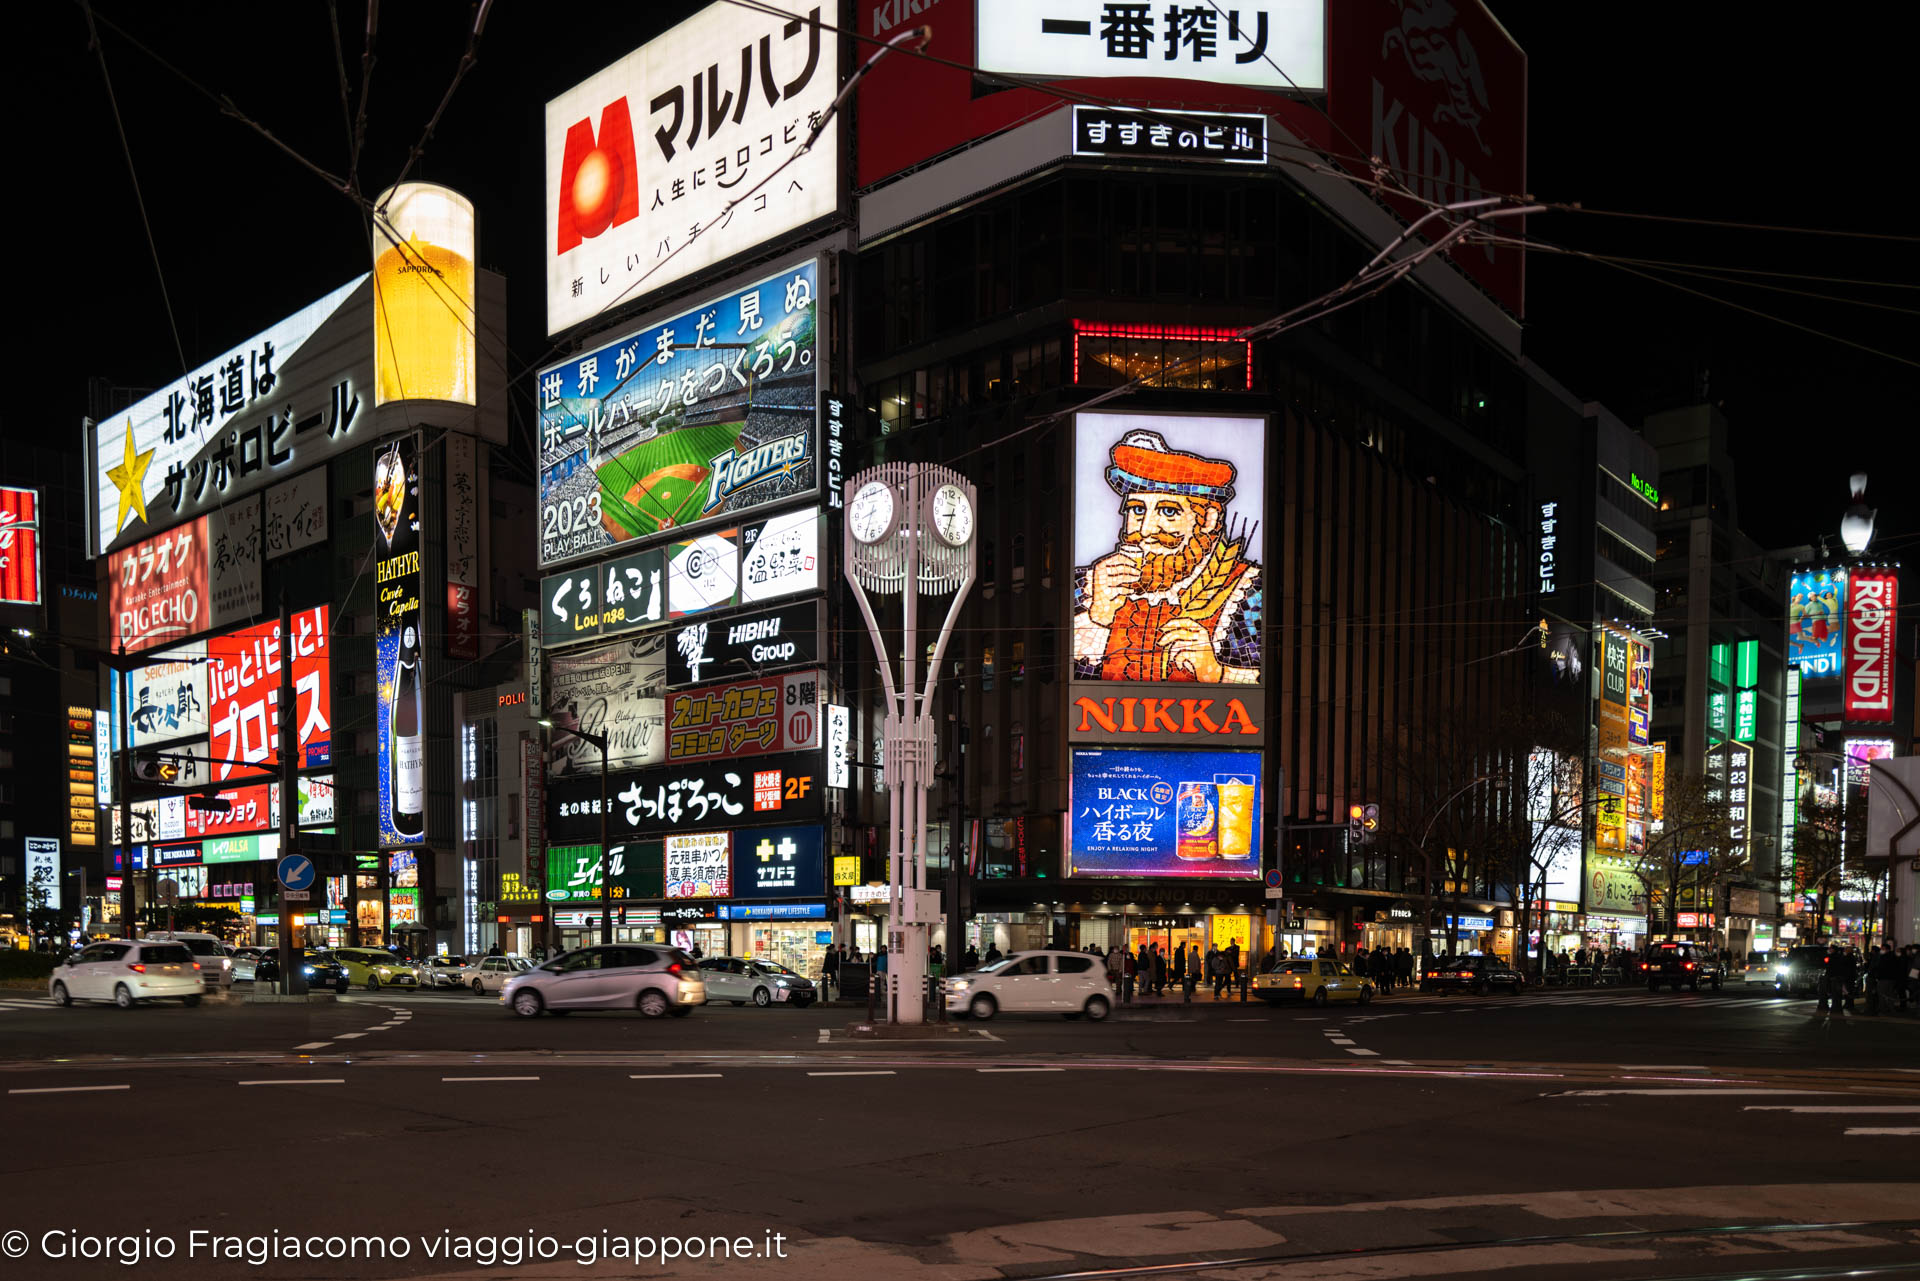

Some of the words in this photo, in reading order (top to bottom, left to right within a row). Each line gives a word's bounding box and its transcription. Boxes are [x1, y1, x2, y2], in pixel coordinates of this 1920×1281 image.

[1042, 3, 1269, 64] 一番搾り
[651, 6, 821, 163] マルハン
[1086, 120, 1254, 151] すすきのビル
[651, 110, 822, 211] 人生にヨロコビを
[571, 180, 804, 298] 新しいパチンコへ
[397, 265, 434, 275] SAPPORO
[542, 274, 811, 410] 世界がまだ見ぬ
[163, 341, 277, 444] 北海道は
[543, 331, 811, 452] ボールパークをつくろう。
[829, 399, 843, 509] すすきのビル
[703, 430, 809, 514] FIGHTERS
[543, 491, 603, 540] 2023
[544, 537, 571, 557] PLAY
[573, 532, 601, 551] BALL
[744, 528, 759, 544] 2F
[1540, 502, 1557, 593] すすきのビル
[122, 533, 192, 588] カラオケ
[377, 551, 420, 584] HATHYR
[149, 577, 189, 598] Entertainment
[380, 584, 404, 603] Cuvée
[552, 566, 643, 622] くろねこ
[119, 606, 150, 645] BIG
[151, 589, 199, 625] ECHO
[389, 597, 420, 617] Capella
[456, 585, 471, 645] カラオケ
[574, 607, 625, 631] Lounge
[728, 617, 781, 645] HIBIKI
[751, 642, 795, 662] Group
[1606, 643, 1626, 673] 快活
[786, 681, 816, 706] 8階
[1607, 674, 1625, 694] CLUB
[131, 680, 201, 733] 長次郎
[671, 687, 778, 729] ネットカフェ
[1074, 696, 1260, 734] NIKKA
[670, 730, 726, 758] コミック
[729, 721, 778, 752] ダーツ
[618, 772, 744, 826] さっぽろっこ
[784, 776, 811, 801] 2F
[1098, 787, 1149, 801] BLACK
[1080, 804, 1166, 821] ハイボール
[1091, 821, 1154, 842] 香る夜
[568, 845, 625, 887] エイル
[669, 848, 721, 865] 元祖串かつ
[669, 864, 727, 881] 恵美須商店
[757, 866, 796, 879] サツドラ
[573, 887, 630, 898] 家賃の半分!
[858, 890, 890, 898] すすきのビ
[774, 907, 787, 915] HAPPY
[788, 906, 811, 914] LIFESTYLE
